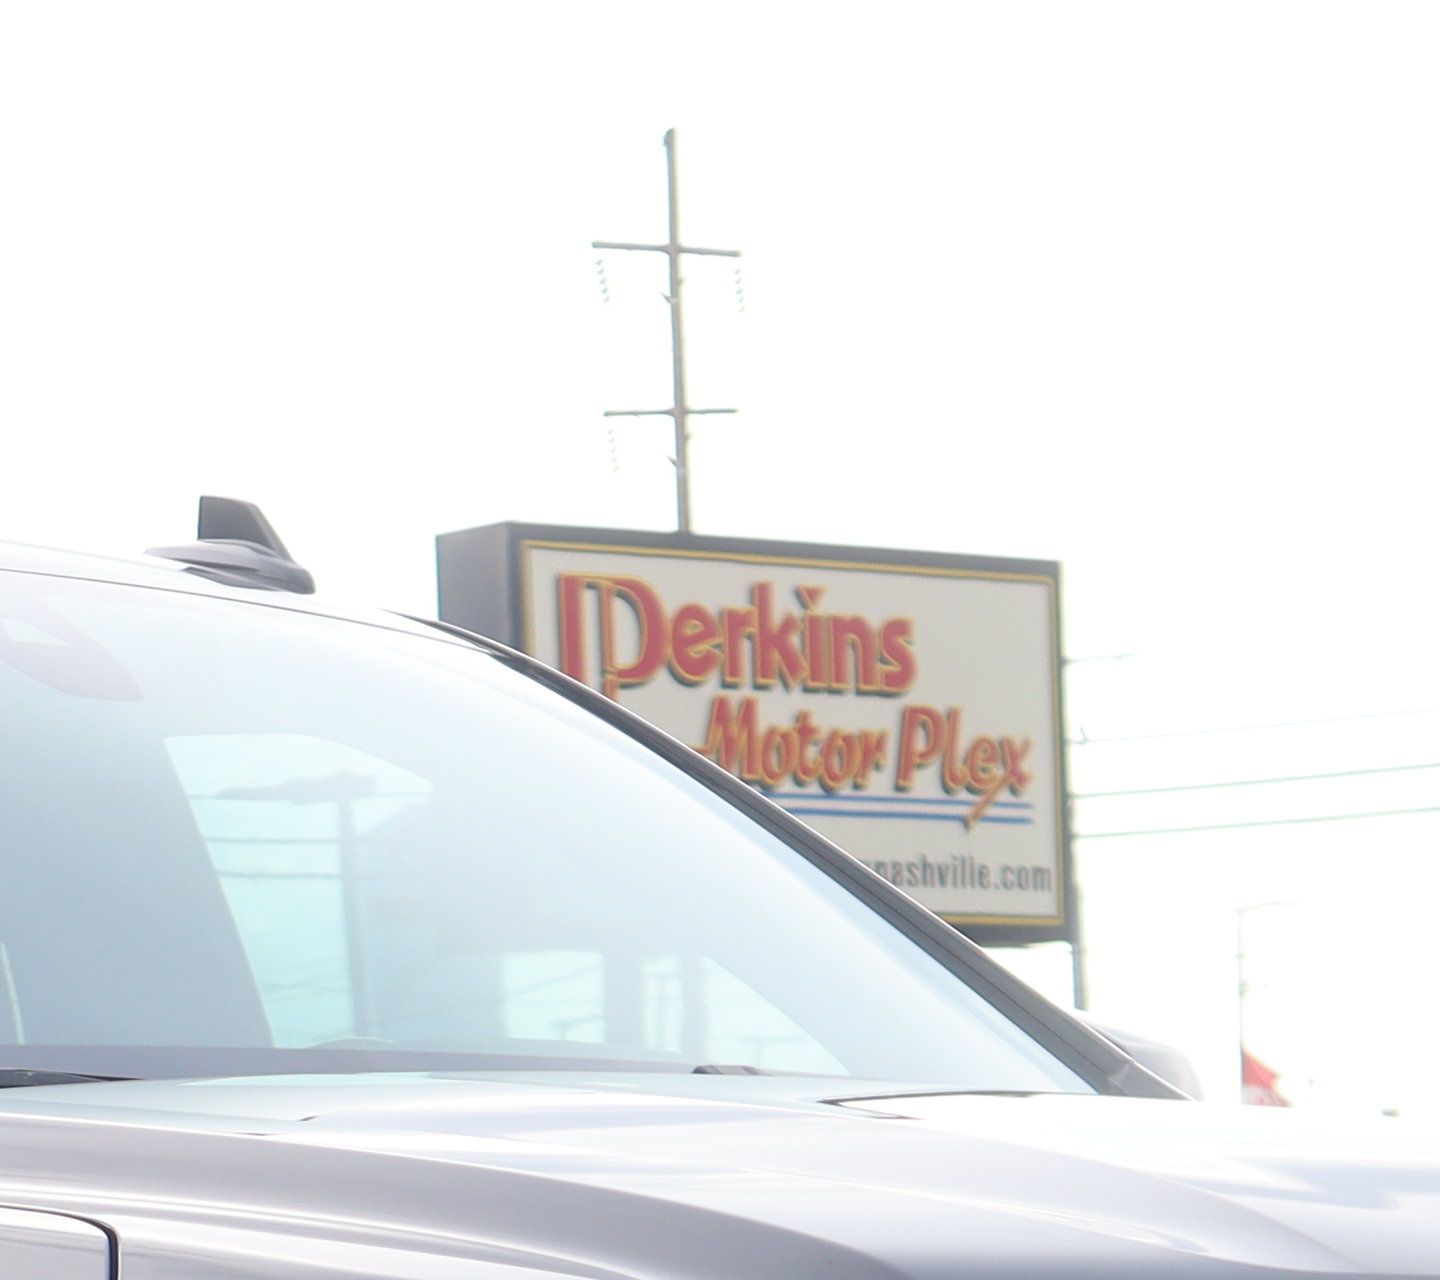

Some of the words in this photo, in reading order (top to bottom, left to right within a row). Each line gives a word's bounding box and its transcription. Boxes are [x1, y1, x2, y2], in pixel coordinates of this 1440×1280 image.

[556, 570, 918, 702] Perkins
[693, 694, 888, 788] Motor
[895, 705, 1033, 829] Plex
[862, 853, 1053, 894] nashville.com
